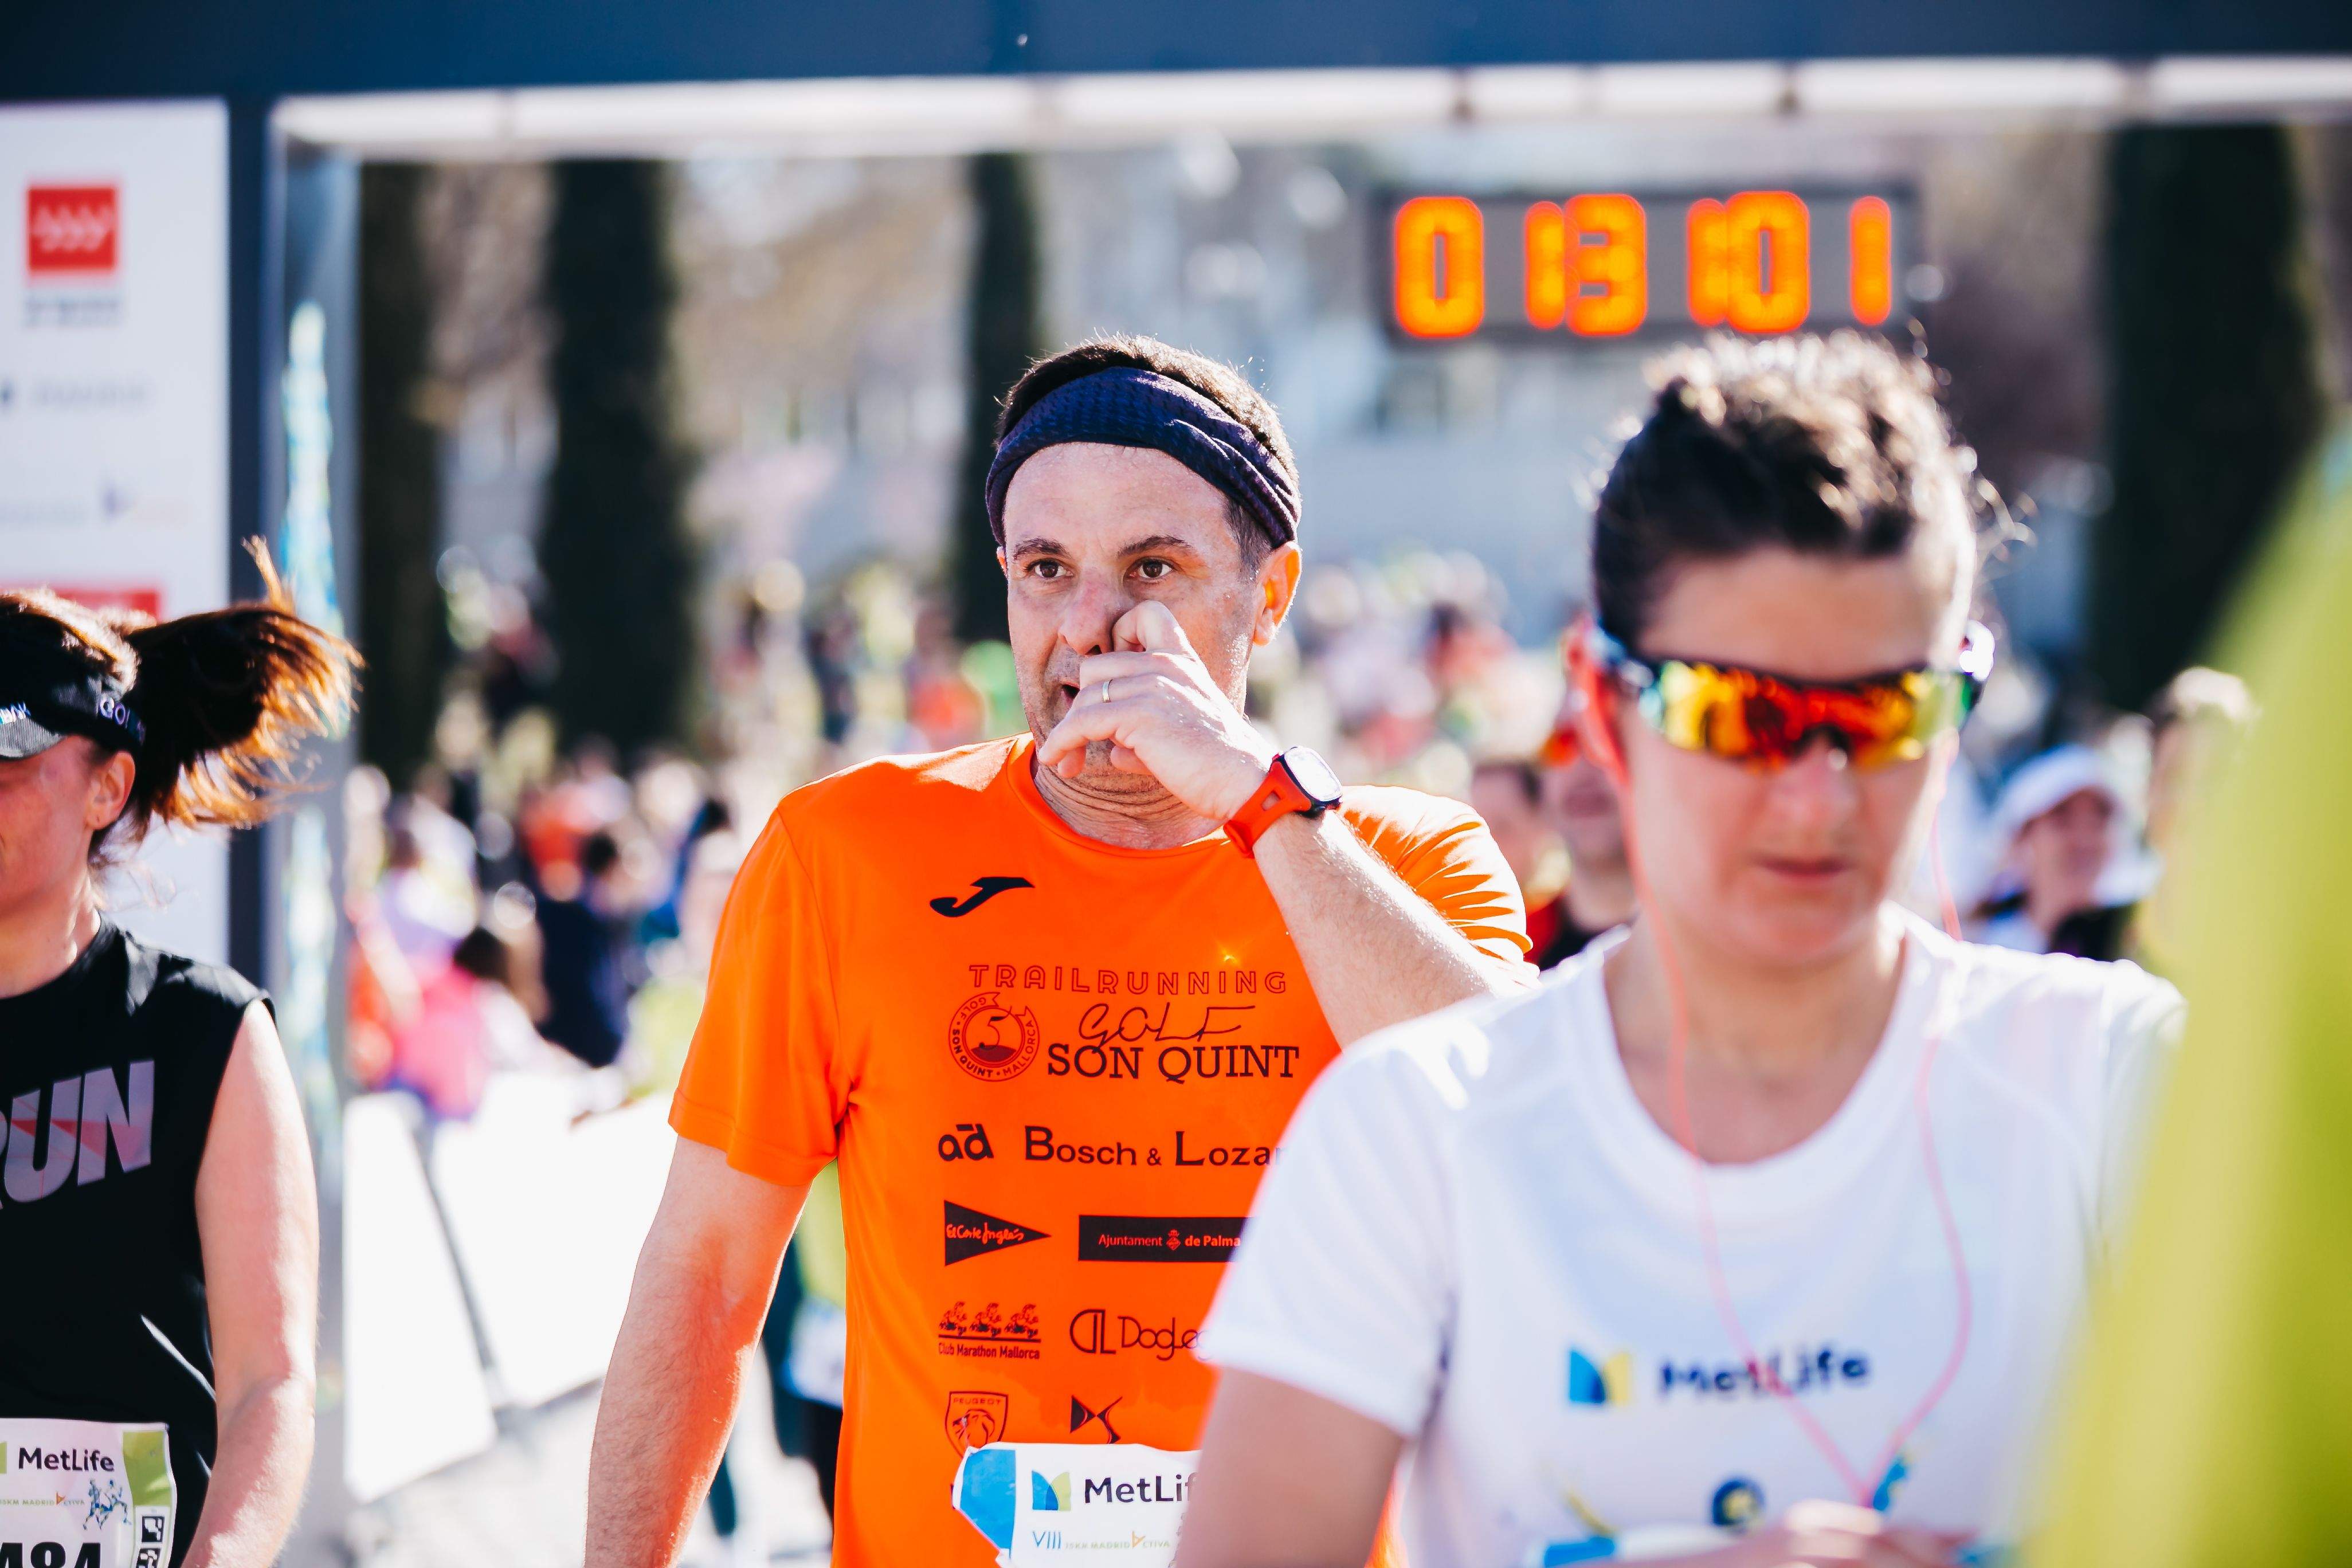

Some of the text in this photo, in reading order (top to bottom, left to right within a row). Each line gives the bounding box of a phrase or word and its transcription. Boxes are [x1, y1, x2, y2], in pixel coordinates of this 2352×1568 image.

[969, 965, 1287, 995] TRAILRUNNING
[952, 1029, 963, 1055] SON
[959, 1055, 994, 1078] QUINT
[1002, 1020, 1036, 1076] MALLORCA
[1048, 1042, 1299, 1084] SON QUINT
[0, 1059, 155, 1209] UN
[1024, 1126, 1137, 1166] Bosch
[1147, 1147, 1162, 1166] &
[1098, 1234, 1241, 1248] Ajuntament de Palma
[957, 1344, 997, 1358] Marathon
[999, 1345, 1040, 1360] Mallorca
[18, 1447, 115, 1472] MetLife
[1032, 1531, 1061, 1550] VIII
